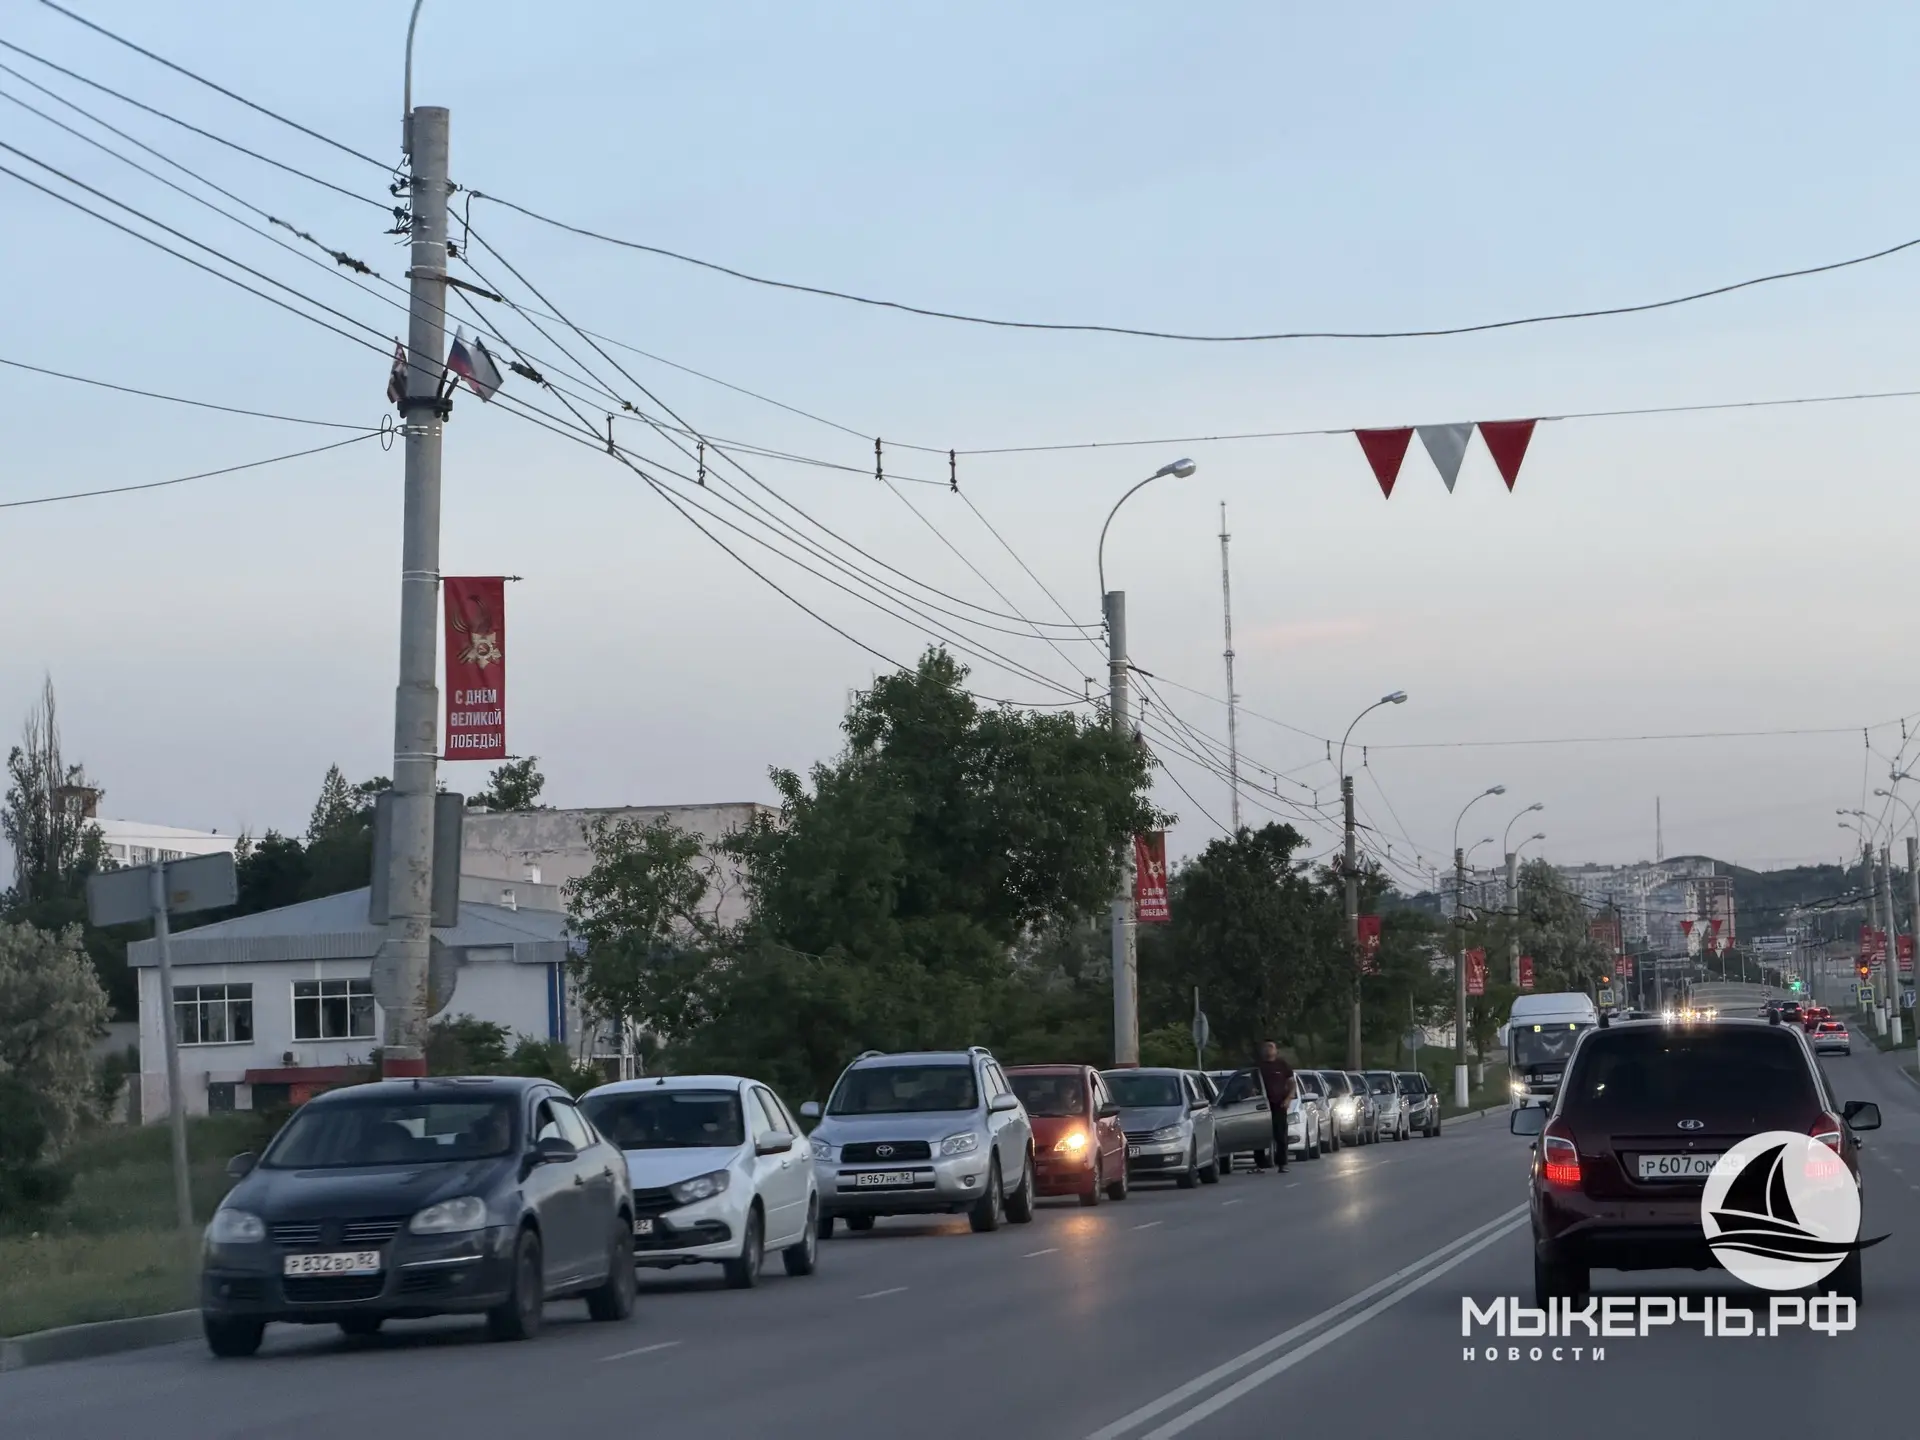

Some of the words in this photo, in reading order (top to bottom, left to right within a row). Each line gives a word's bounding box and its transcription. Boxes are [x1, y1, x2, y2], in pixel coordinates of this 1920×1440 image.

[455, 690, 463, 704] С
[451, 708, 502, 726] ВЕЛИКОЙ
[451, 733, 502, 749] ПОБЕДЫ!
